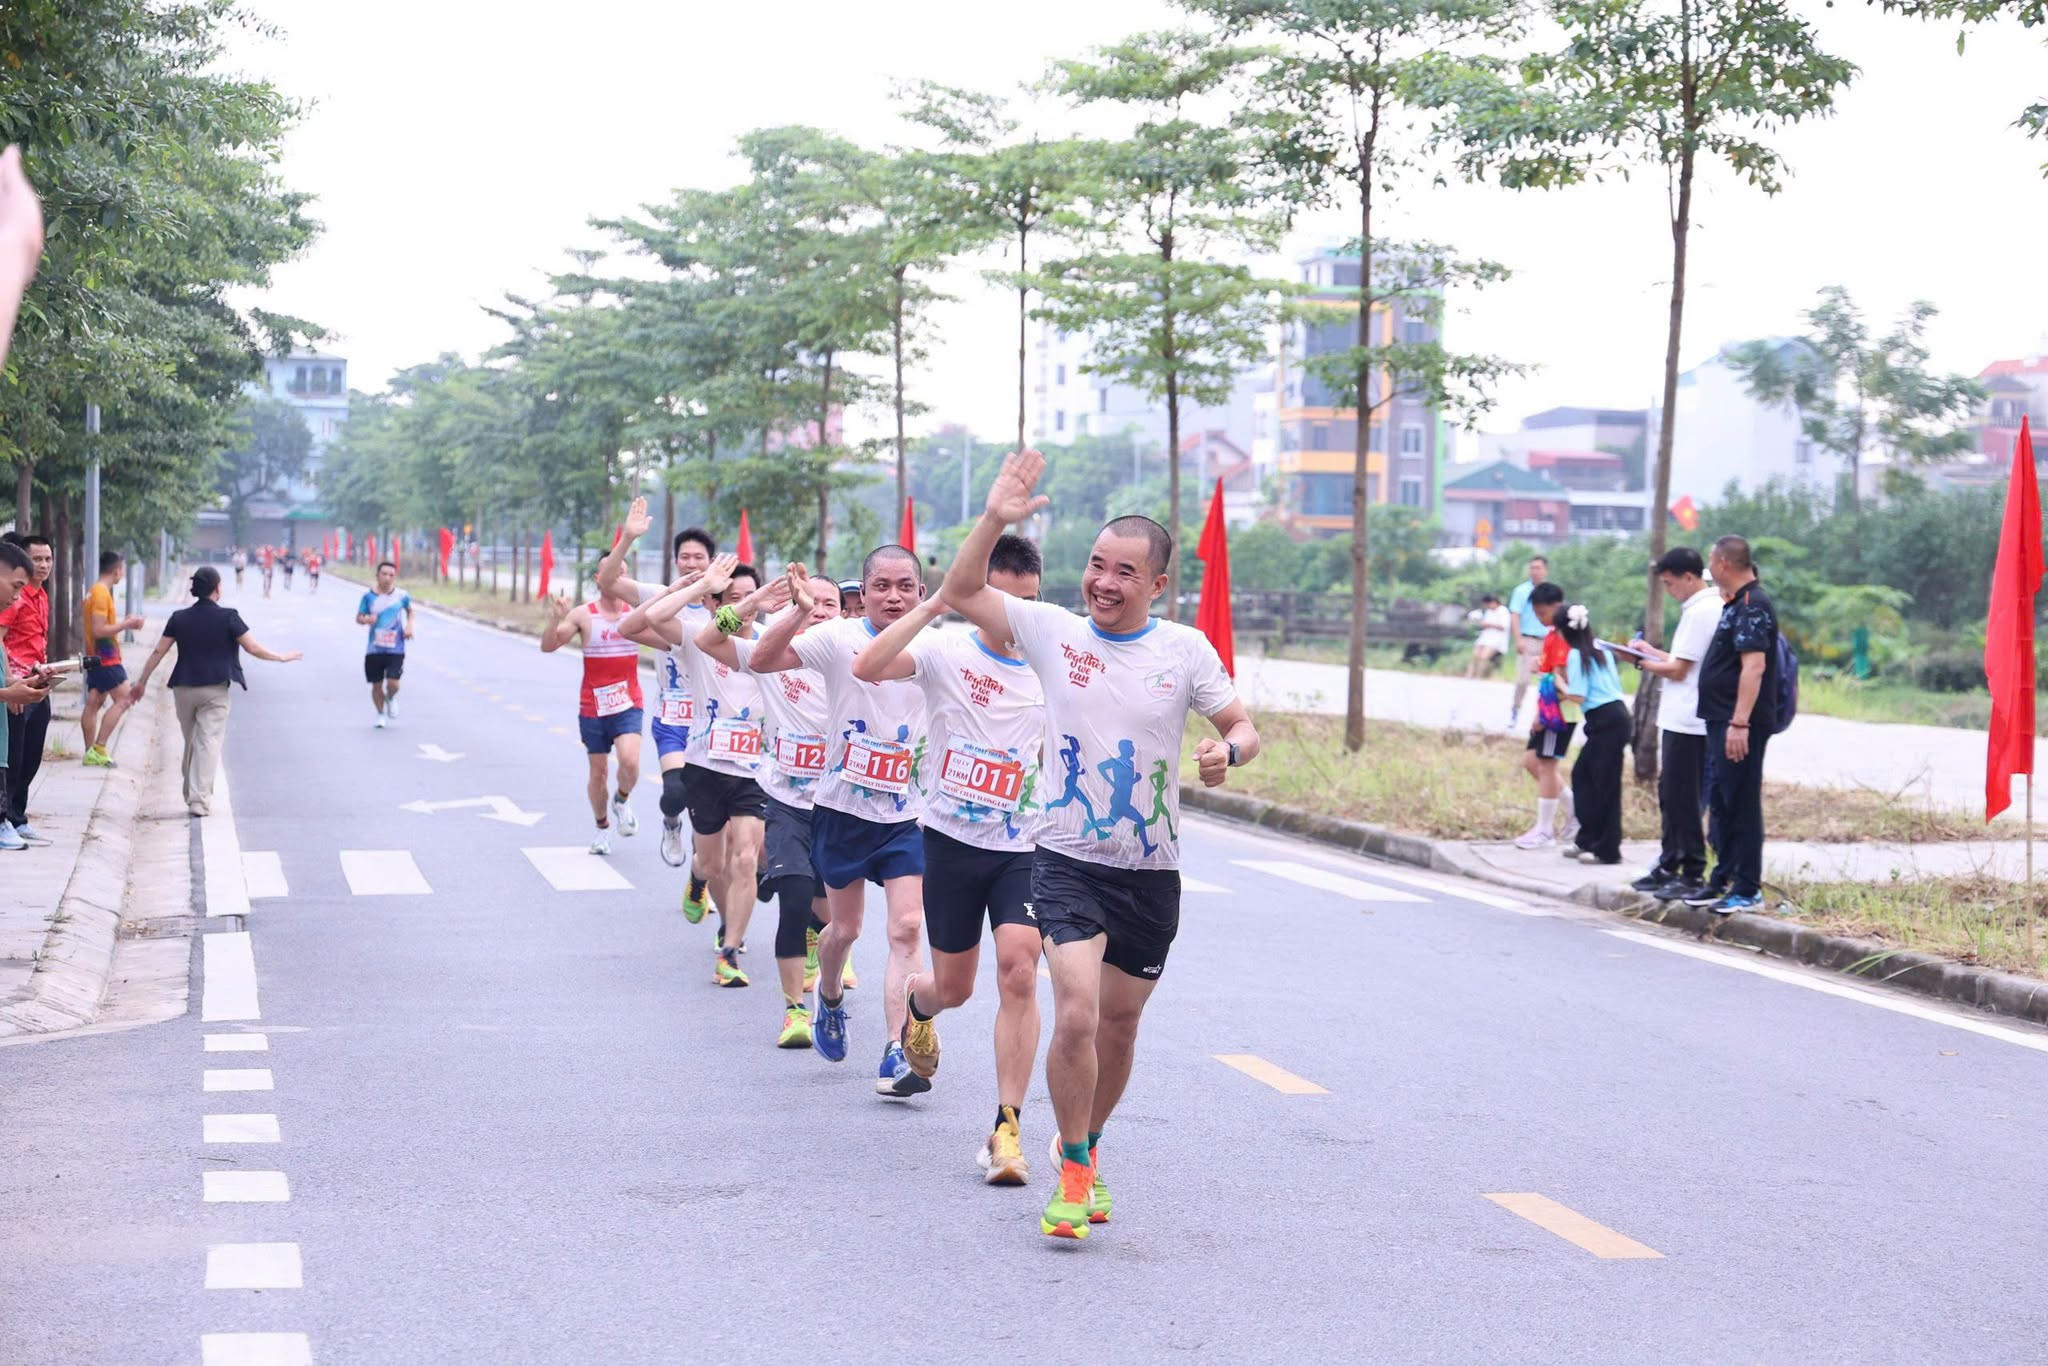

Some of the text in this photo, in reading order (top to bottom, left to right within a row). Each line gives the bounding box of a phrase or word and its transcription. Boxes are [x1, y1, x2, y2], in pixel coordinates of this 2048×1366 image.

[1061, 642, 1106, 674] together
[1078, 665, 1091, 674] we
[960, 668, 1005, 696] together
[1069, 671, 1089, 684] can
[970, 692, 990, 704] can
[978, 686, 990, 696] we
[680, 701, 693, 717] 01
[732, 734, 758, 753] 121
[848, 760, 866, 770] 21KM
[871, 756, 908, 780] 116
[948, 769, 968, 781] 21KM
[971, 762, 1017, 796] 011
